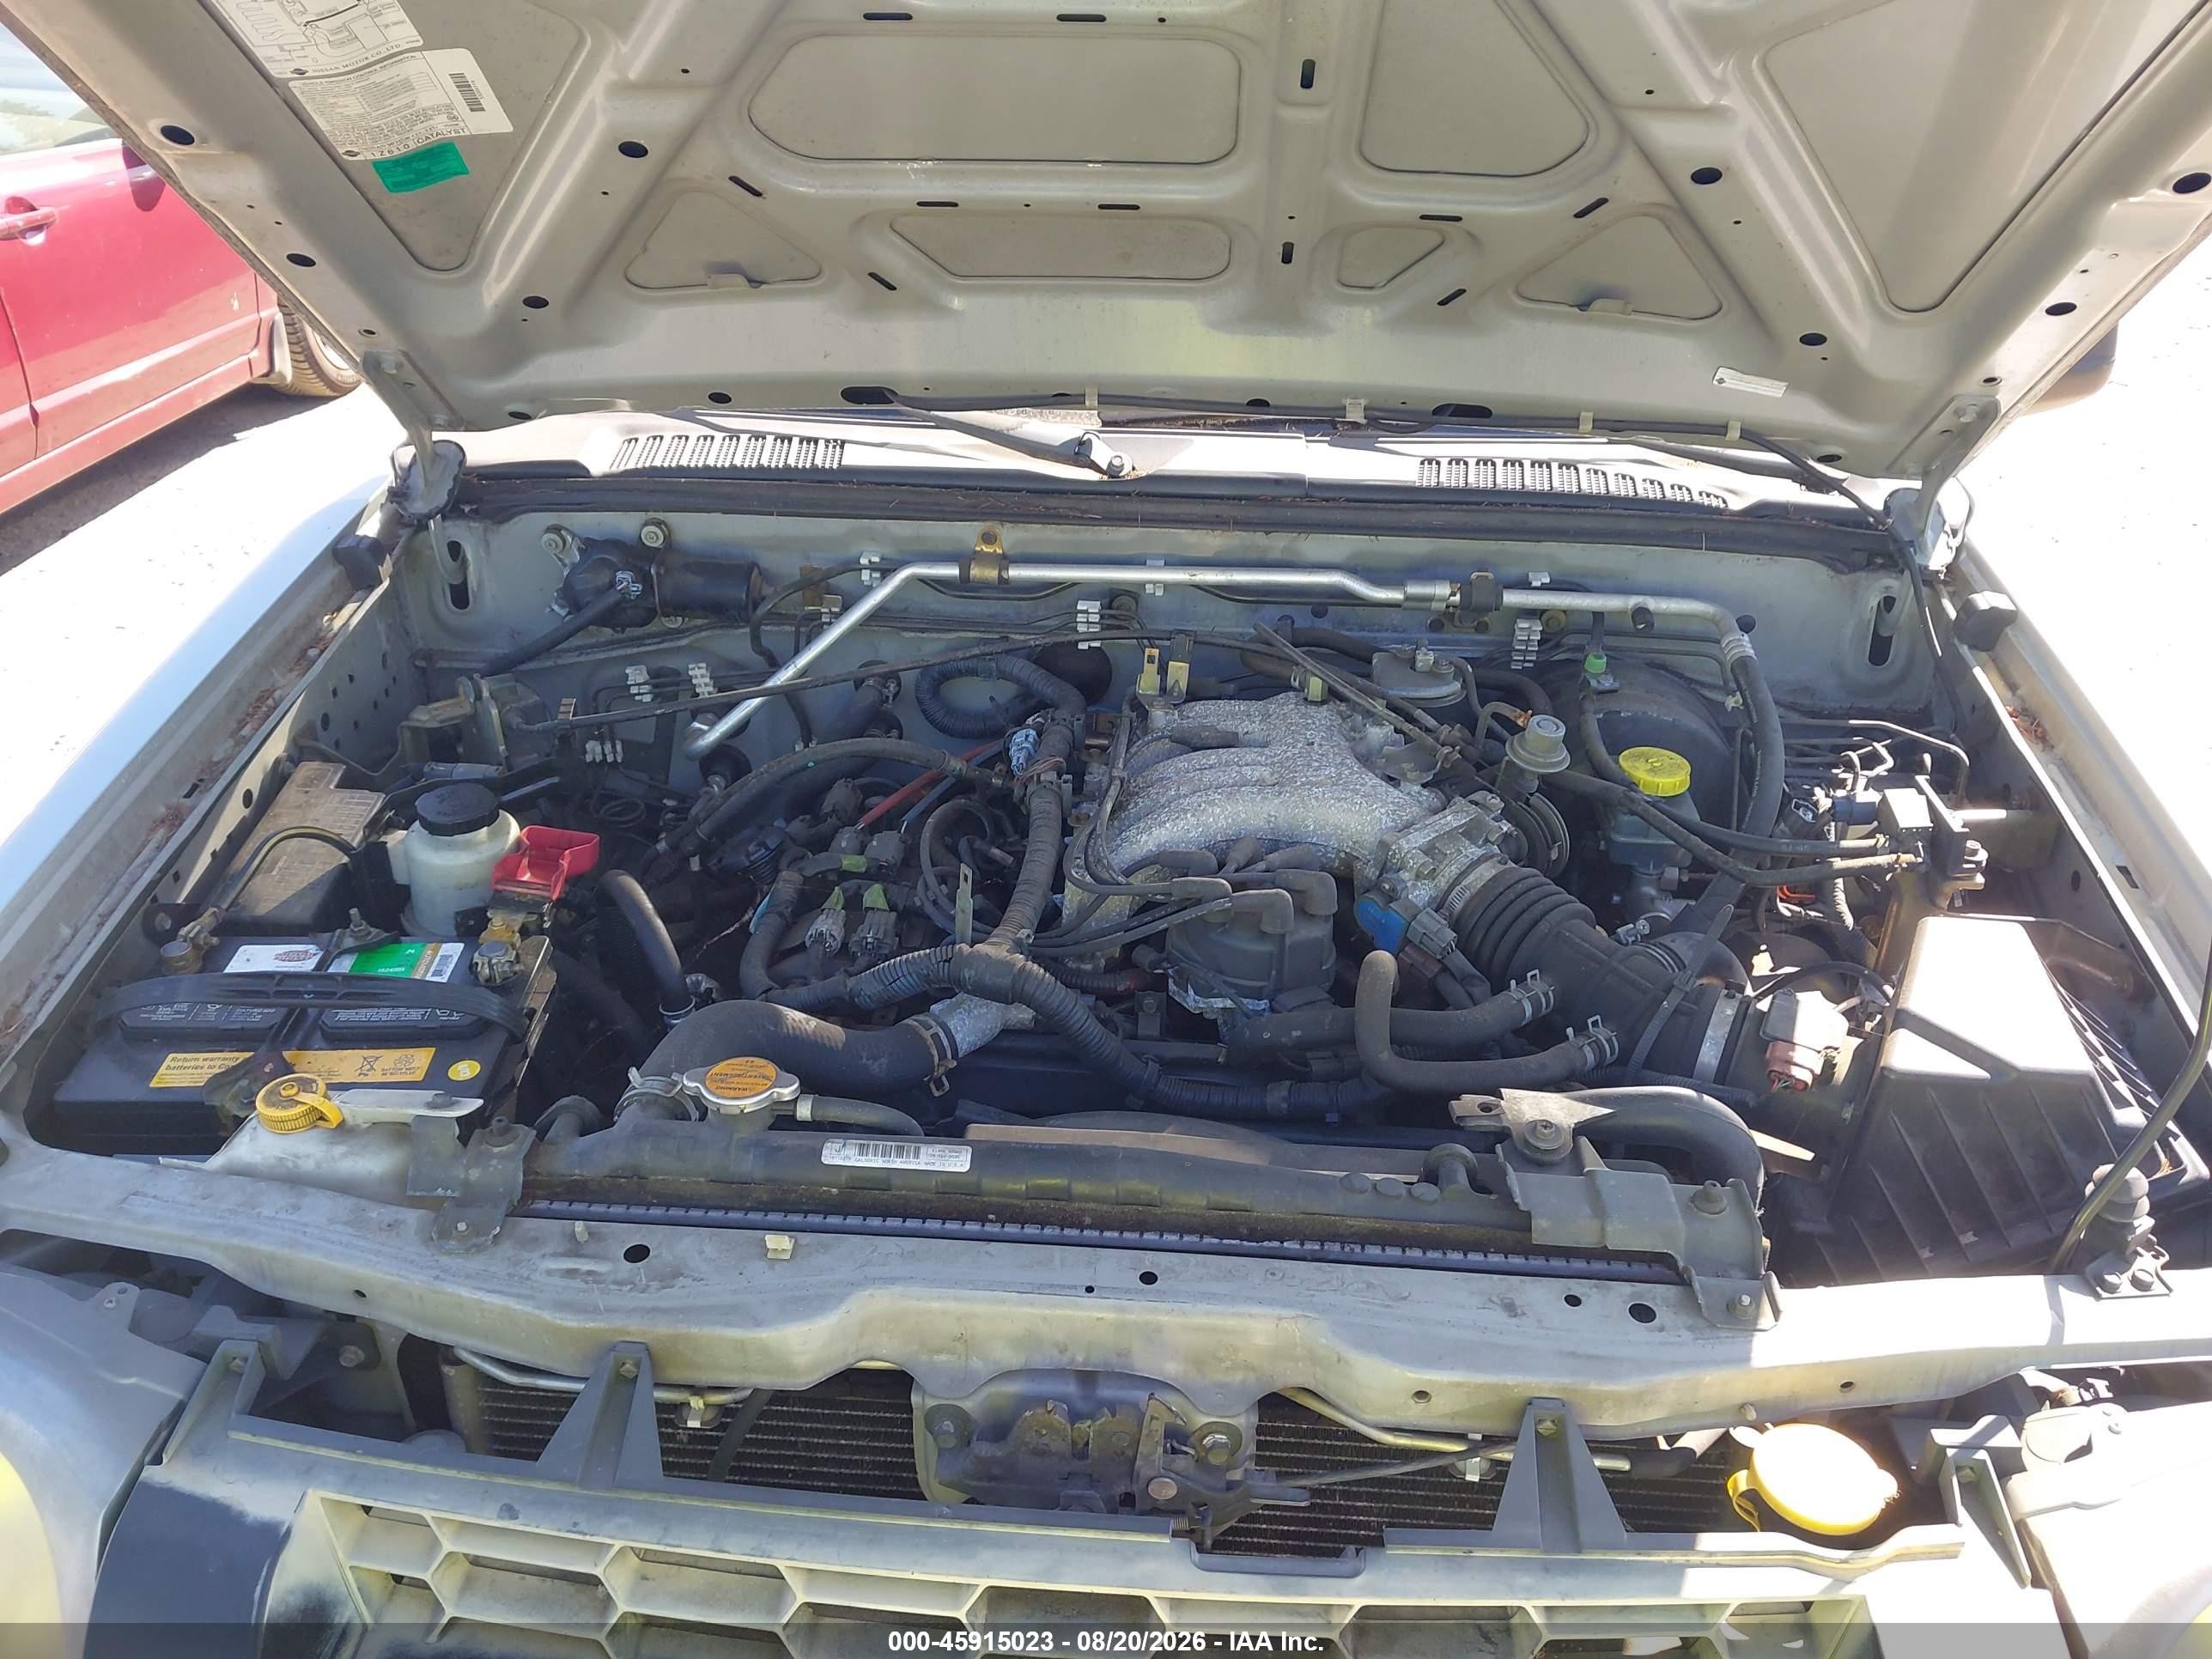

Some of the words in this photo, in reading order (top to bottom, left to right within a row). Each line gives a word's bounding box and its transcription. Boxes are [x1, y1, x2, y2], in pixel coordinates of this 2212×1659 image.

[312, 65, 340, 74] NISSAN
[342, 57, 368, 69] MOTOR
[416, 129, 466, 144] CATALYST
